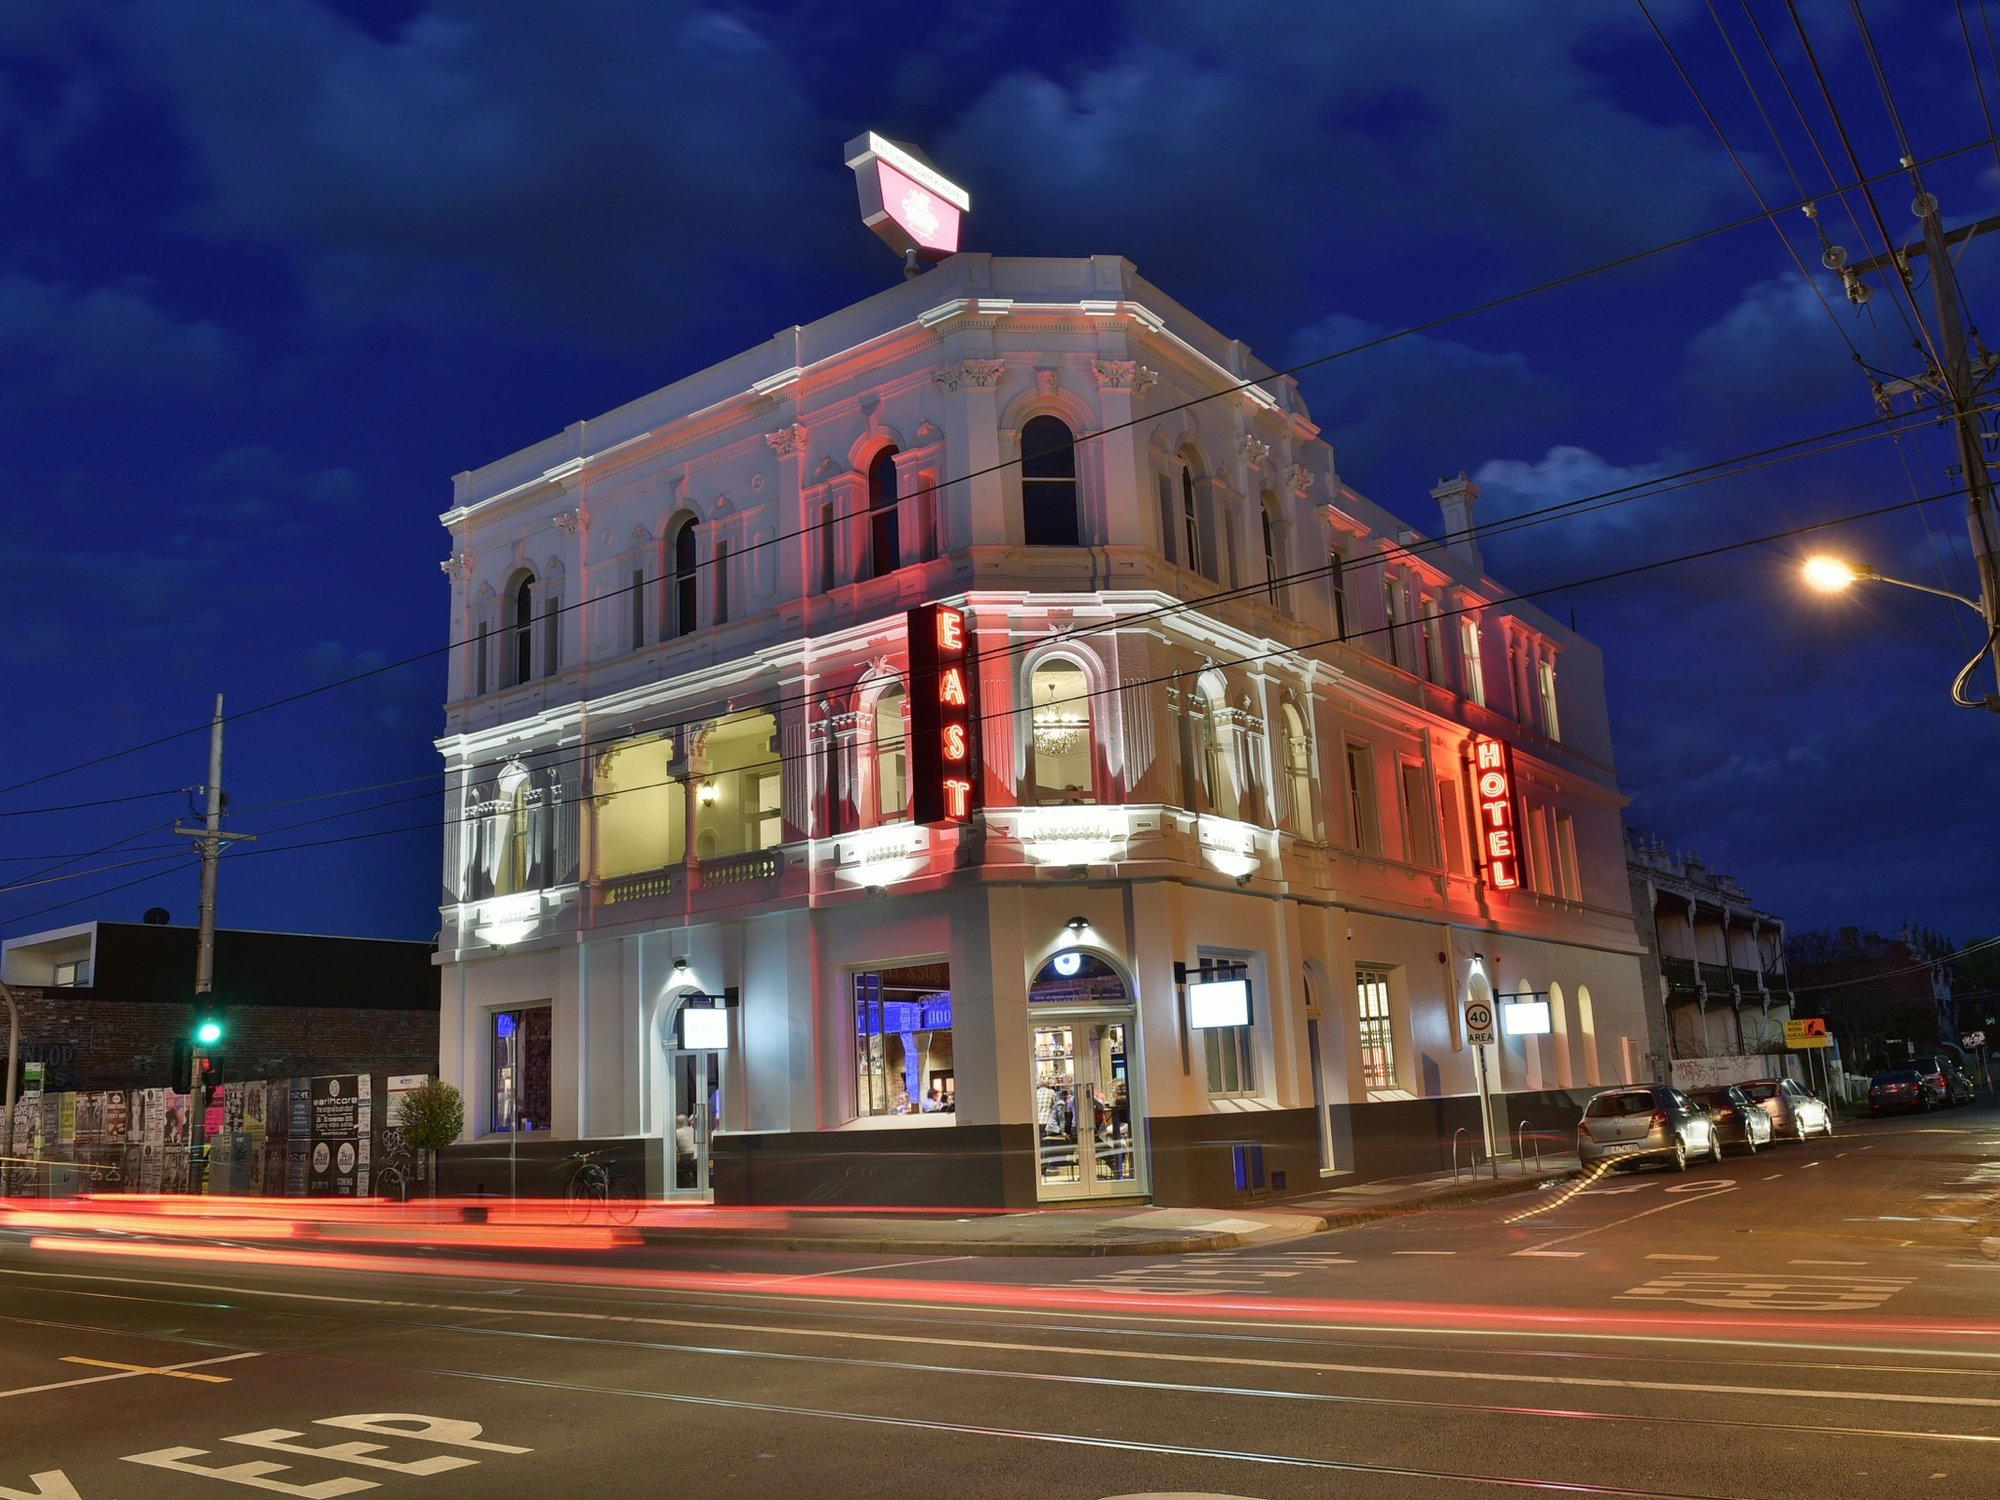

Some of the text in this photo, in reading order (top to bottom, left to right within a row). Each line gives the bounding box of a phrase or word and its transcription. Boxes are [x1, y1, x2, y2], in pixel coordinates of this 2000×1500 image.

[937, 611, 971, 819] EAST
[1478, 741, 1516, 888] HOTEL
[1469, 1033, 1494, 1042] AREA
[1470, 1011, 1488, 1023] 40
